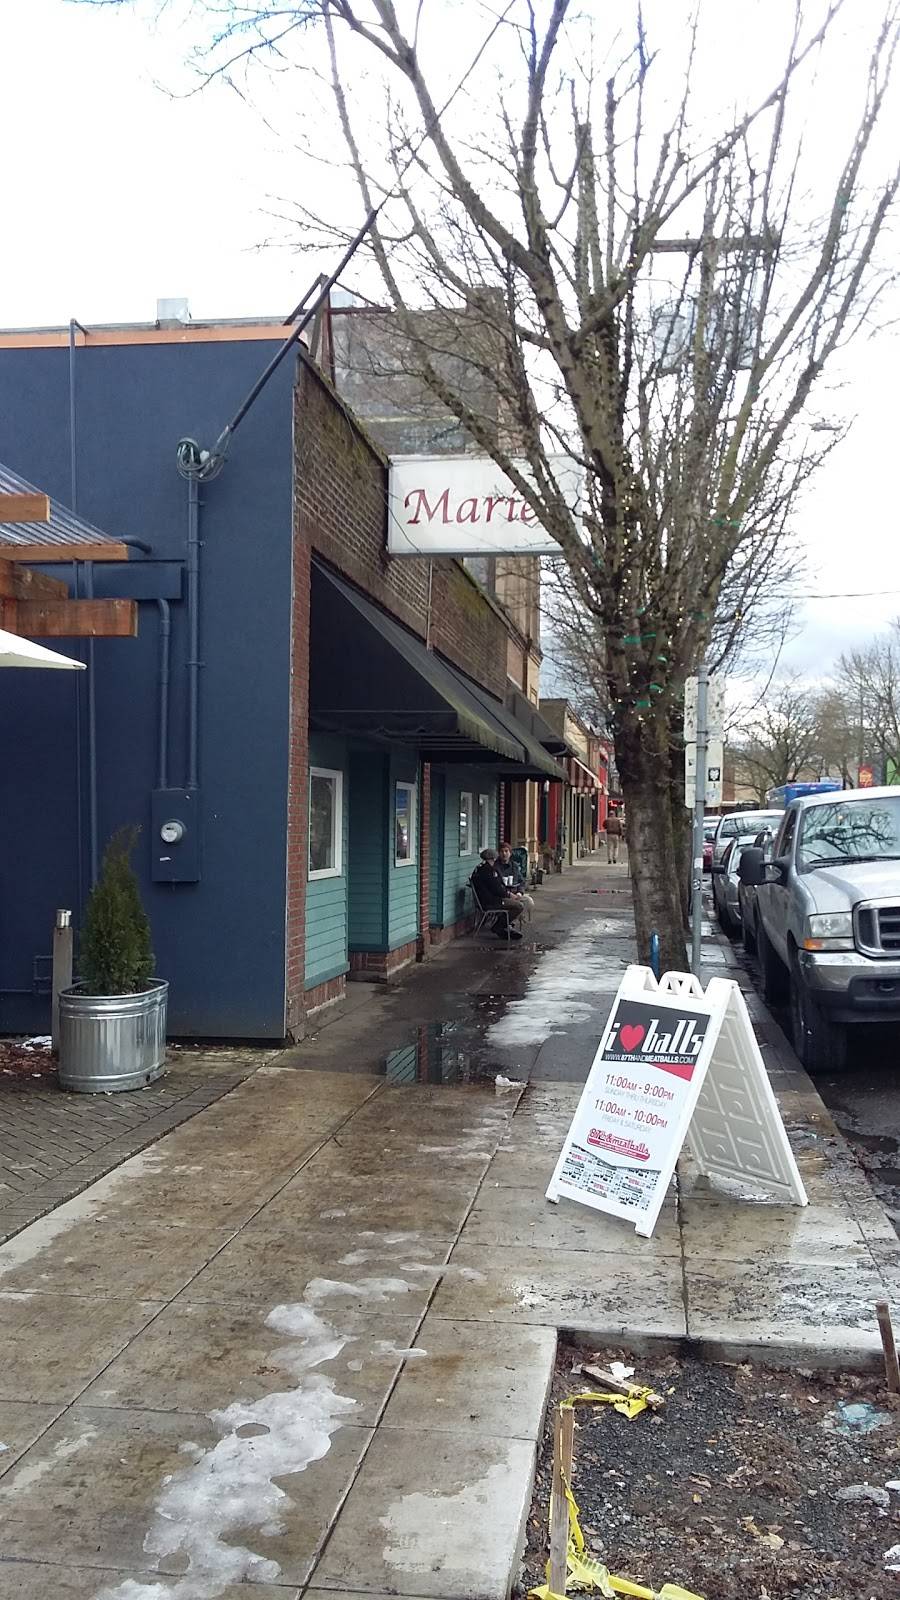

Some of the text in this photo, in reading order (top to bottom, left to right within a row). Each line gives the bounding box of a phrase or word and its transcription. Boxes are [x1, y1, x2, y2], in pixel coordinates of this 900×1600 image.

[605, 1019, 705, 1055] i balls
[605, 1074, 638, 1091] 11:00AM
[643, 1083, 675, 1101] 9:00PM
[594, 1099, 627, 1117] 11:00AM
[633, 1109, 668, 1128] 10:00PM
